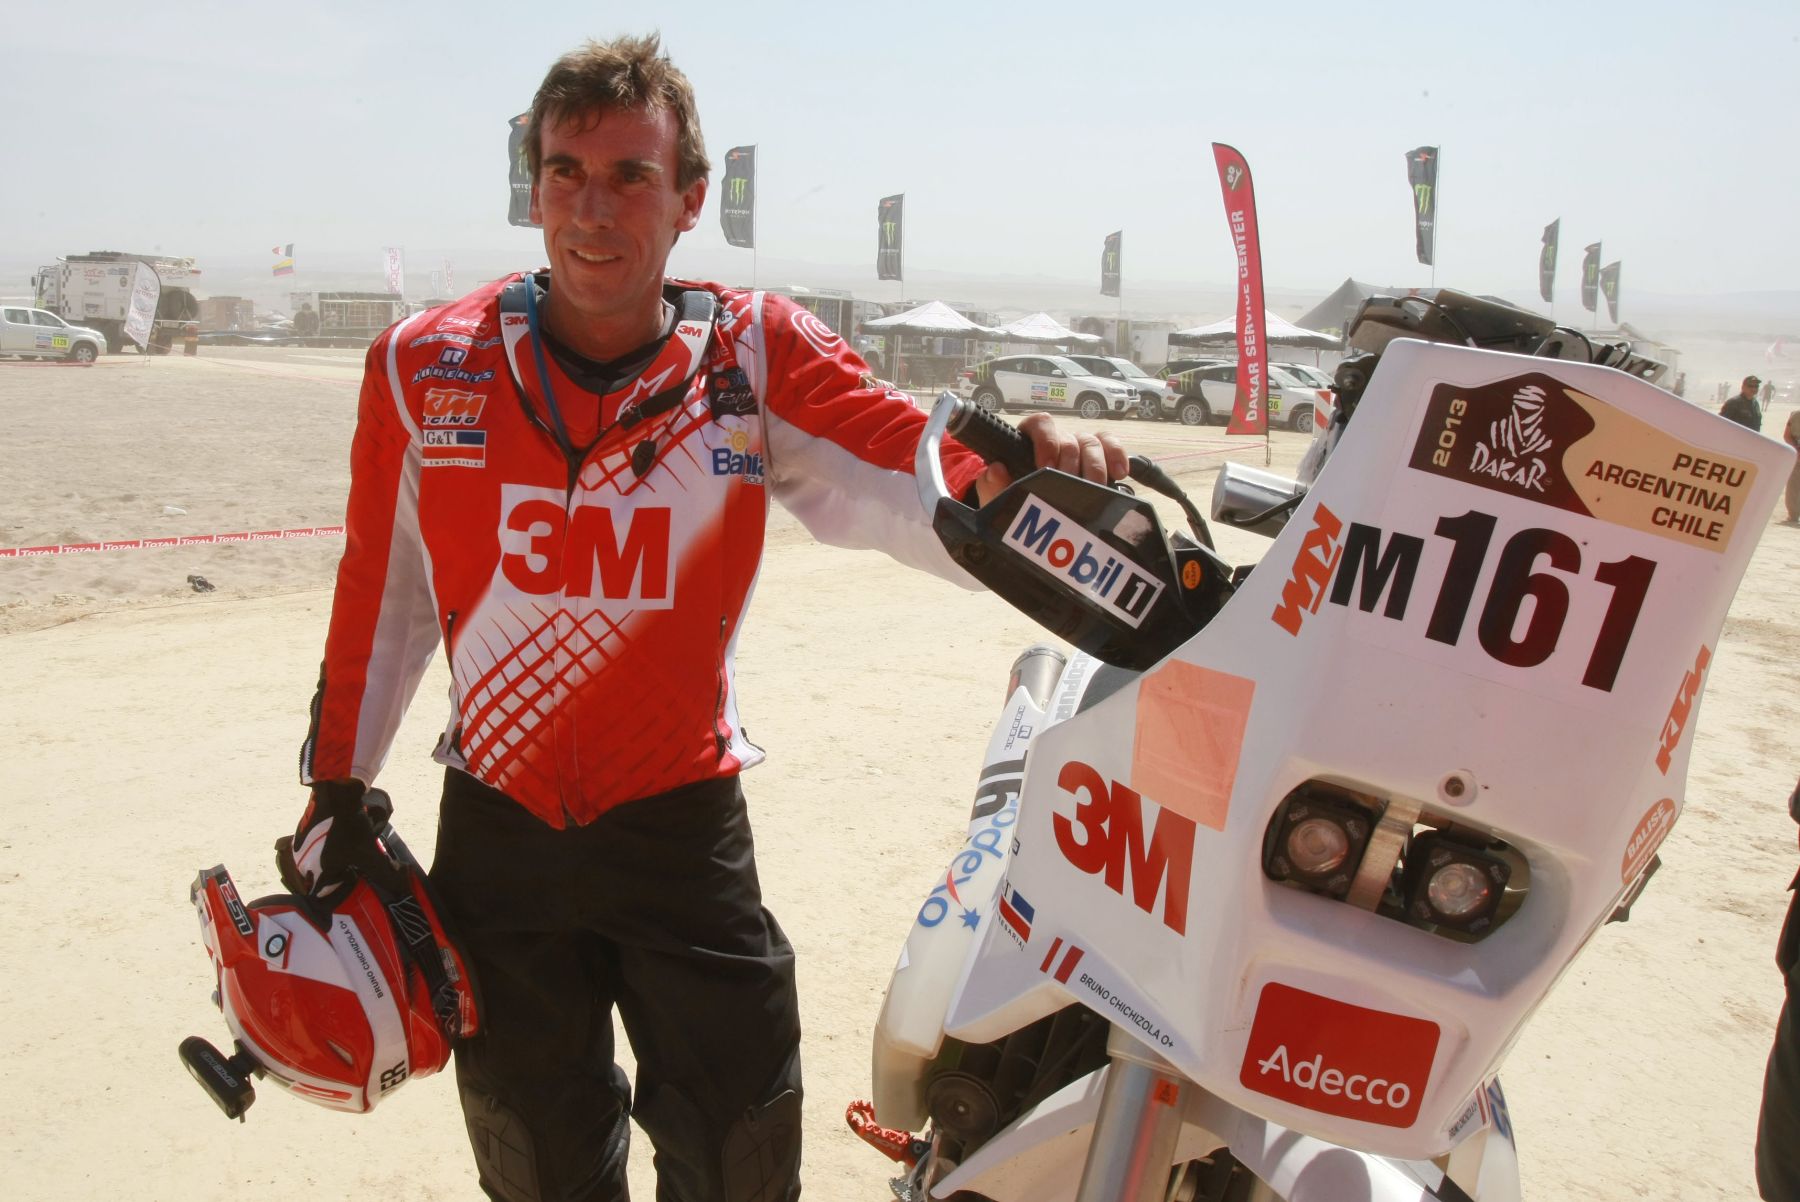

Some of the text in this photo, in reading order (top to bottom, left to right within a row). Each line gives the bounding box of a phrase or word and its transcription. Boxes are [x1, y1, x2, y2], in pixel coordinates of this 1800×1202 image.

[504, 315, 528, 326] 3M
[677, 324, 703, 338] 3M
[1231, 210, 1260, 422] DAKAR SERVICE CENTER
[423, 416, 477, 424] CING
[1267, 400, 1279, 410] 36
[425, 431, 454, 445] G&T
[1432, 398, 1468, 468] 2013
[1469, 441, 1546, 493] DAKAR
[1584, 460, 1732, 515] ARGENTINA
[1671, 453, 1747, 488] PERU
[501, 499, 672, 601] 3M
[1011, 504, 1125, 598] Mobil
[1651, 506, 1725, 542] CHILE
[1271, 501, 1343, 638] KTM
[1655, 644, 1711, 777] KTM
[1052, 760, 1198, 938] 3M
[1626, 801, 1666, 860] BALISE
[344, 929, 371, 971] CHICHIZOLA
[366, 971, 384, 999] BRUNO
[1079, 973, 1174, 1048] BRUNO CHICHIZOLA O+
[1257, 1045, 1411, 1109] Adecco
